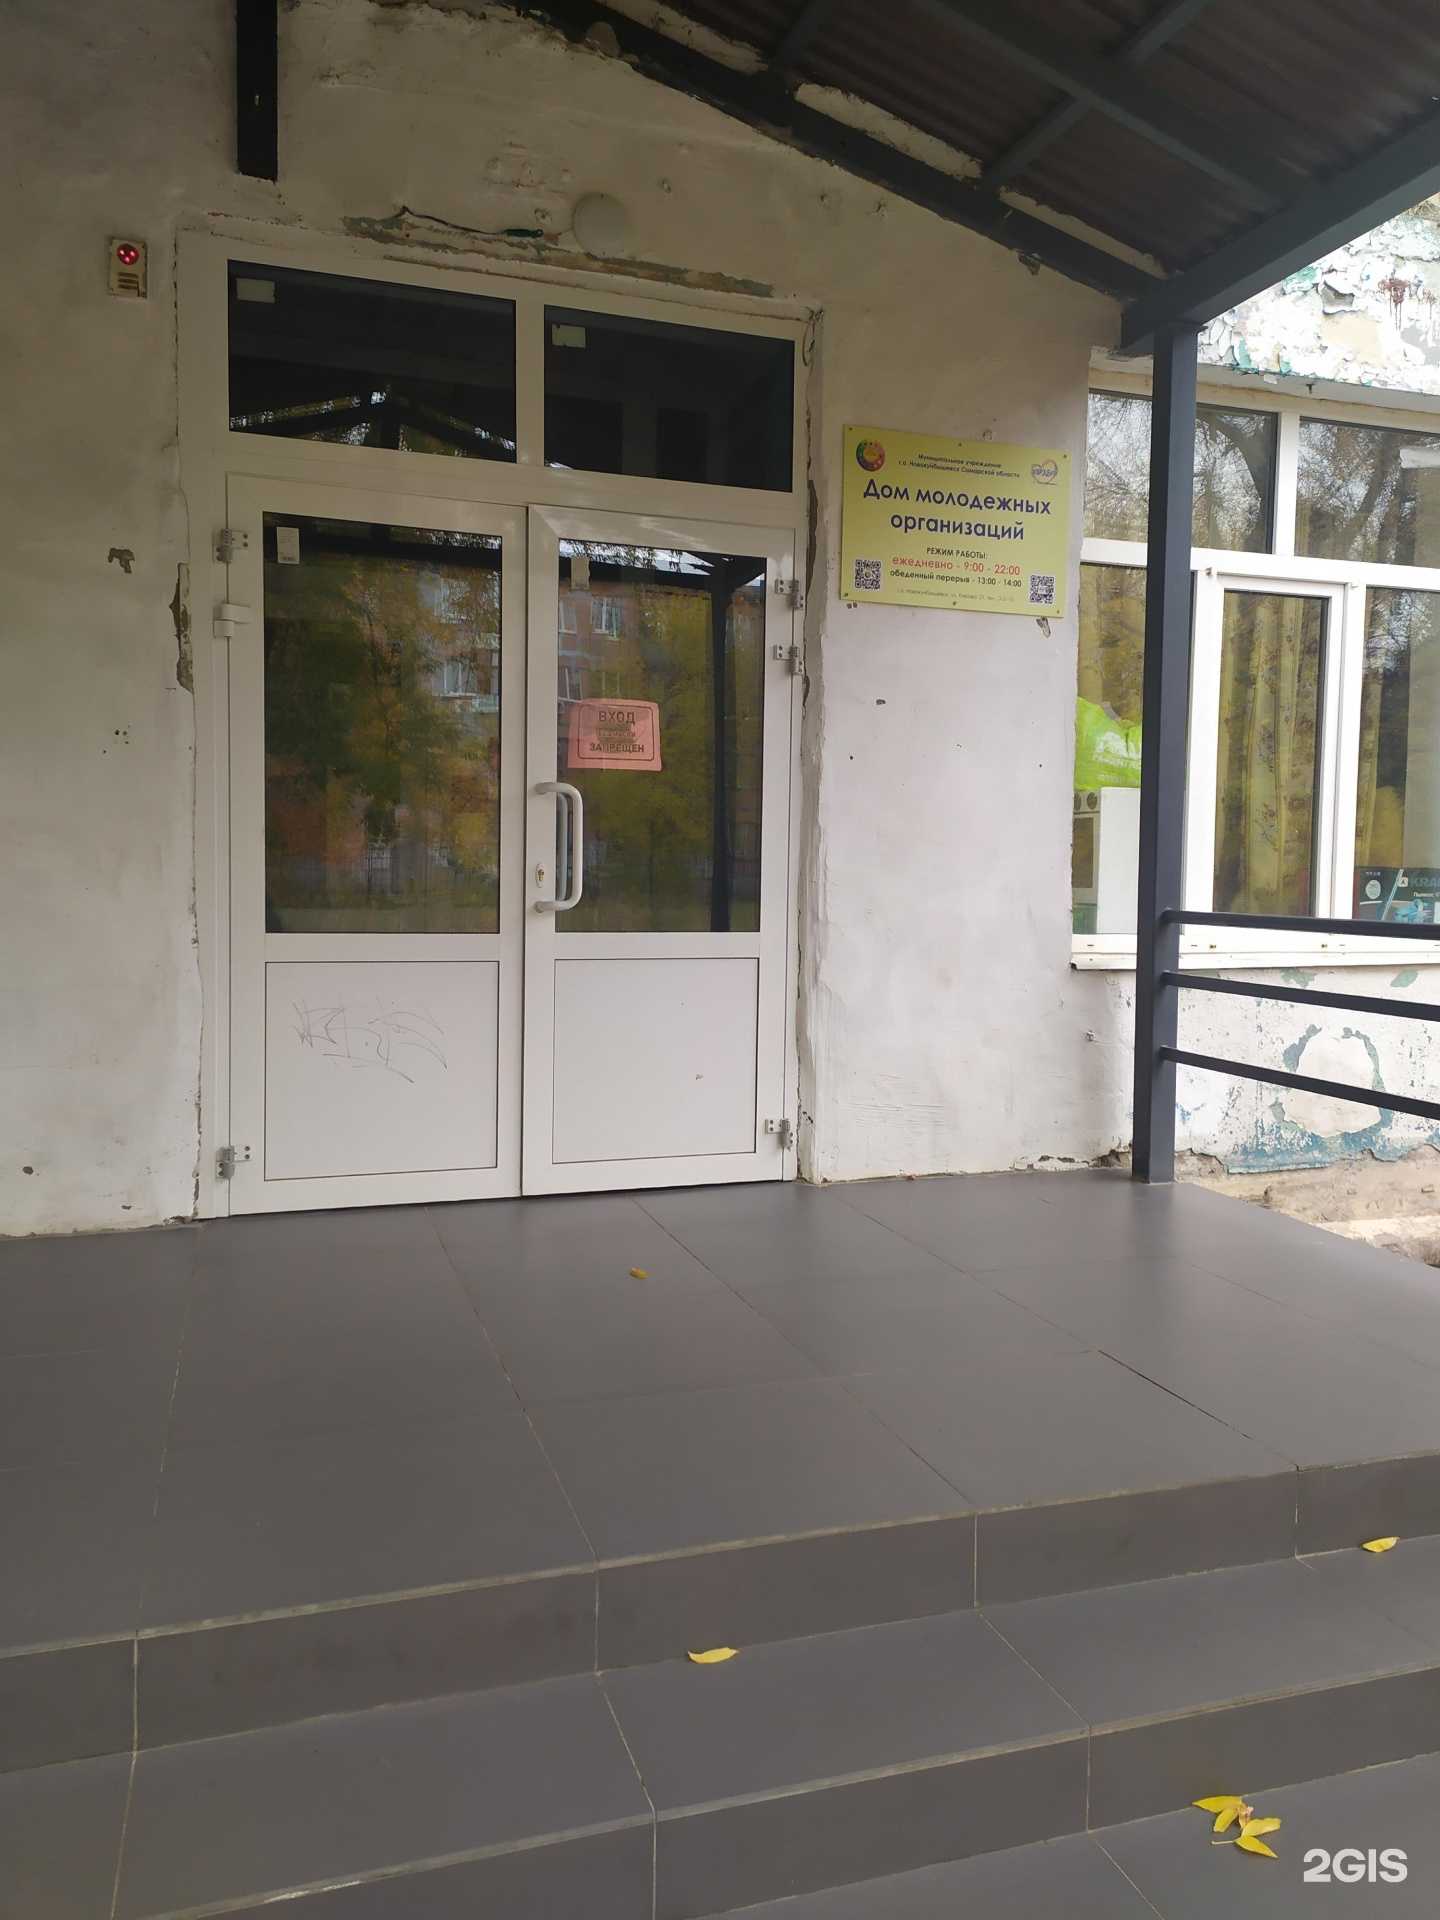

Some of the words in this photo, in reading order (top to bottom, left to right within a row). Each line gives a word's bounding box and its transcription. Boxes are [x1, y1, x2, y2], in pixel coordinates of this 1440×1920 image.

[863, 479, 909, 501] Дом
[915, 488, 1051, 515] молодежных
[890, 512, 1025, 540] организаций
[926, 547, 954, 558] РЕЖИМ
[892, 557, 953, 571] ежедневно
[963, 561, 984, 573] 9:00
[994, 564, 1021, 576] 22:00
[890, 570, 934, 581] обеденный
[935, 573, 970, 585] перерыв
[977, 577, 996, 586] 13:00
[1003, 578, 1022, 588] 14:00
[598, 711, 636, 726] ВХОД
[590, 743, 644, 753] ЗАПРЕЩЕН
